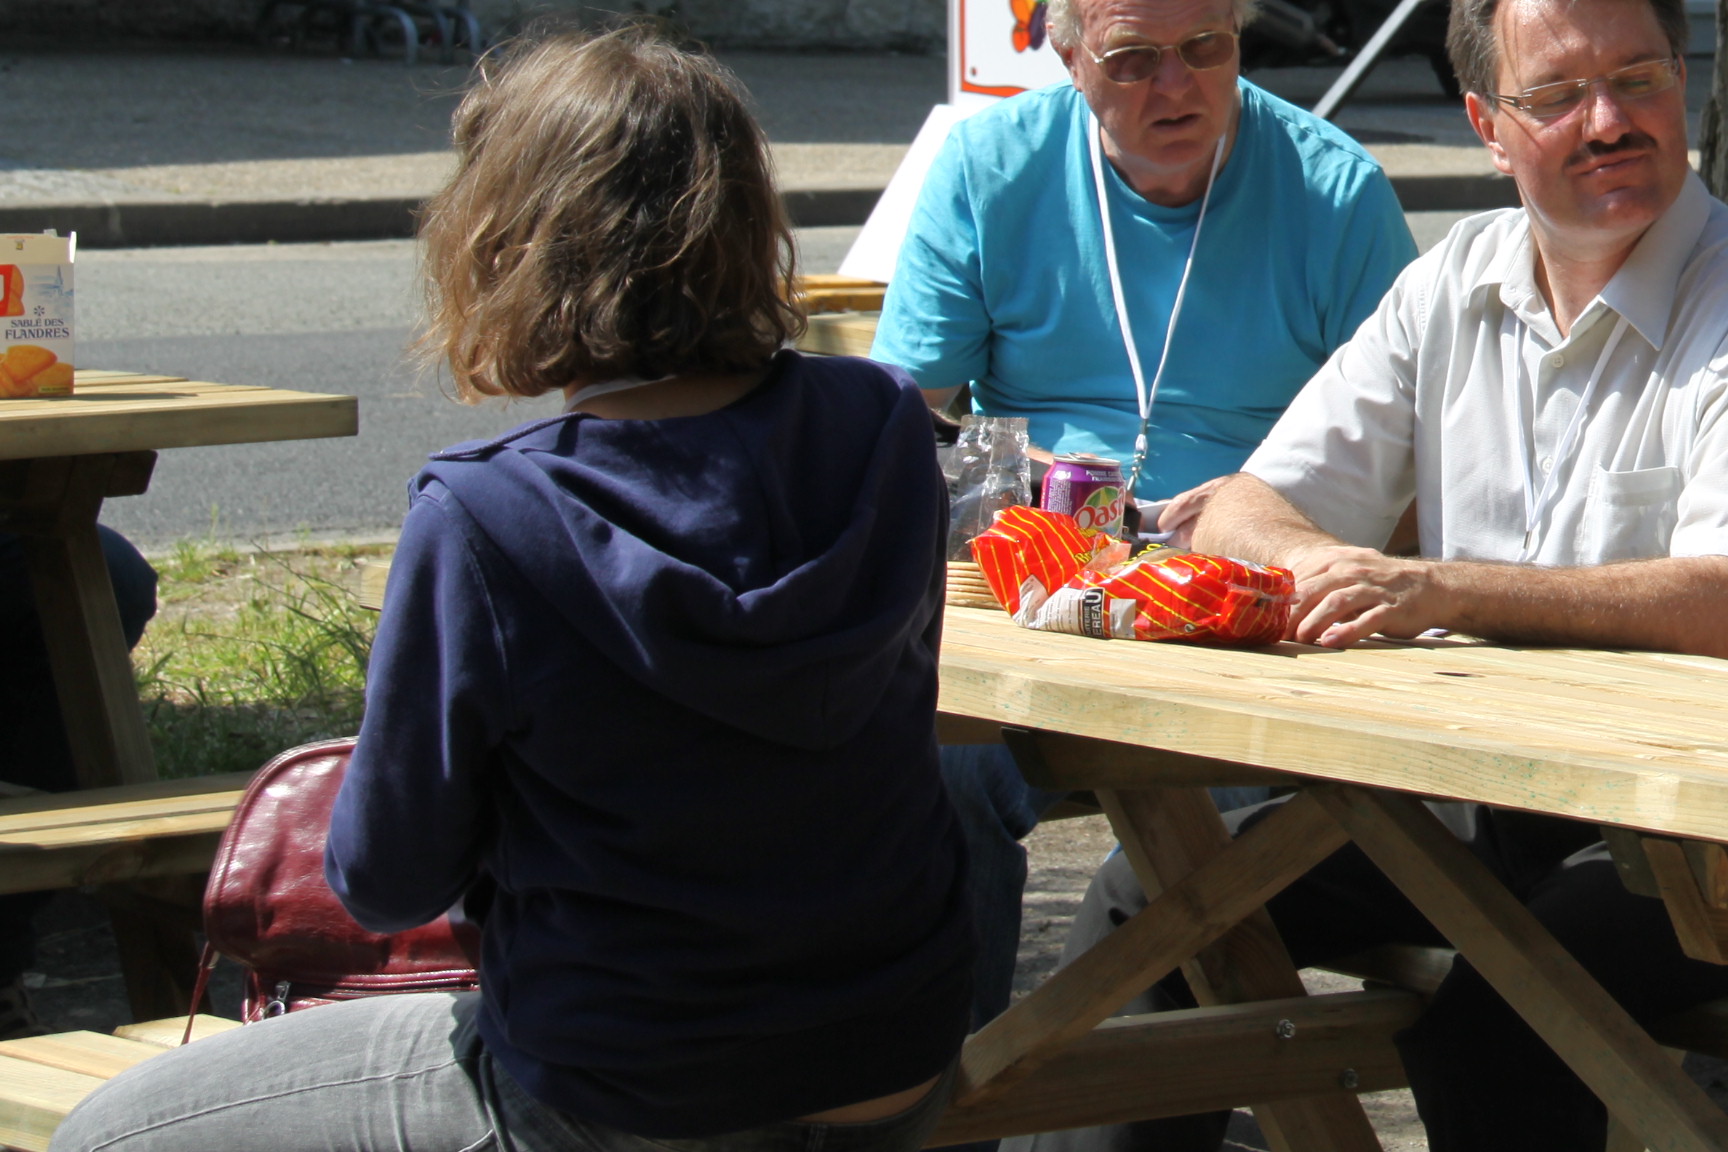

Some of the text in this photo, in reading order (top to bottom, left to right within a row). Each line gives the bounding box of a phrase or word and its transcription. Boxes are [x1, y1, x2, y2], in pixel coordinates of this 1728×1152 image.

[11, 317, 65, 328] SABLÉ DES
[5, 328, 70, 340] FLANDRES
[1075, 486, 1125, 529] Oasi
